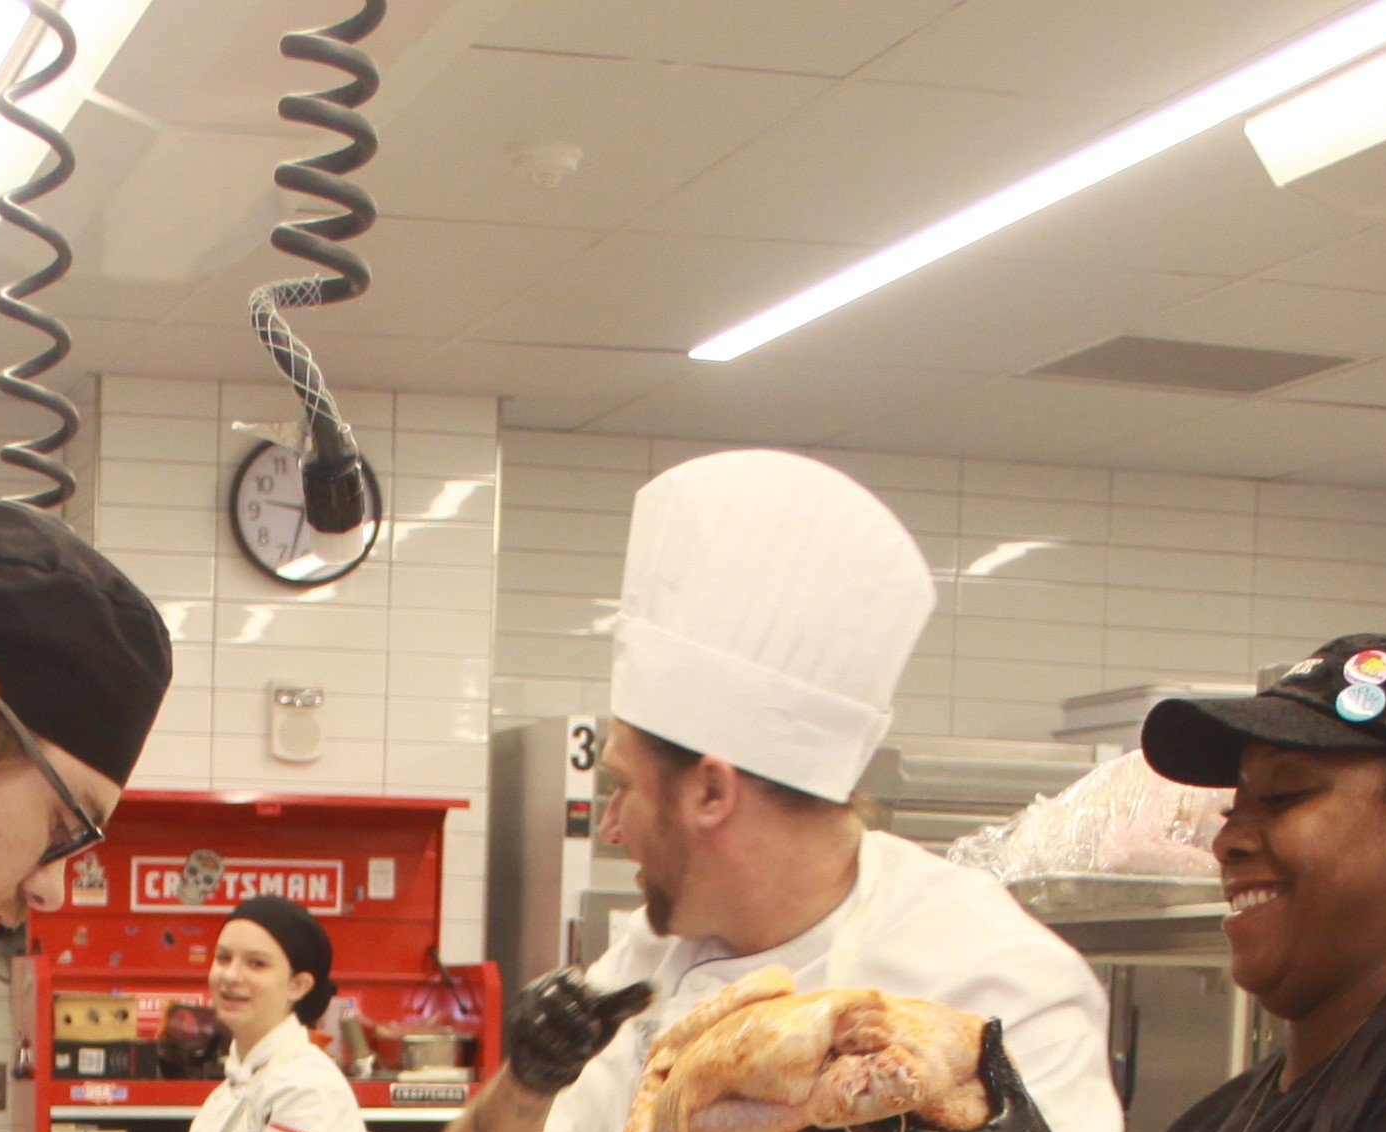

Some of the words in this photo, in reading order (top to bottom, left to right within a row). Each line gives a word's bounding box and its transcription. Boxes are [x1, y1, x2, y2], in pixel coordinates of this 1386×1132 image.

[273, 456, 286, 474] 11
[256, 475, 273, 493] 10
[248, 500, 260, 520] 9
[257, 526, 269, 546] 8
[571, 726, 595, 770] 3
[145, 871, 329, 900] CRTSMAN
